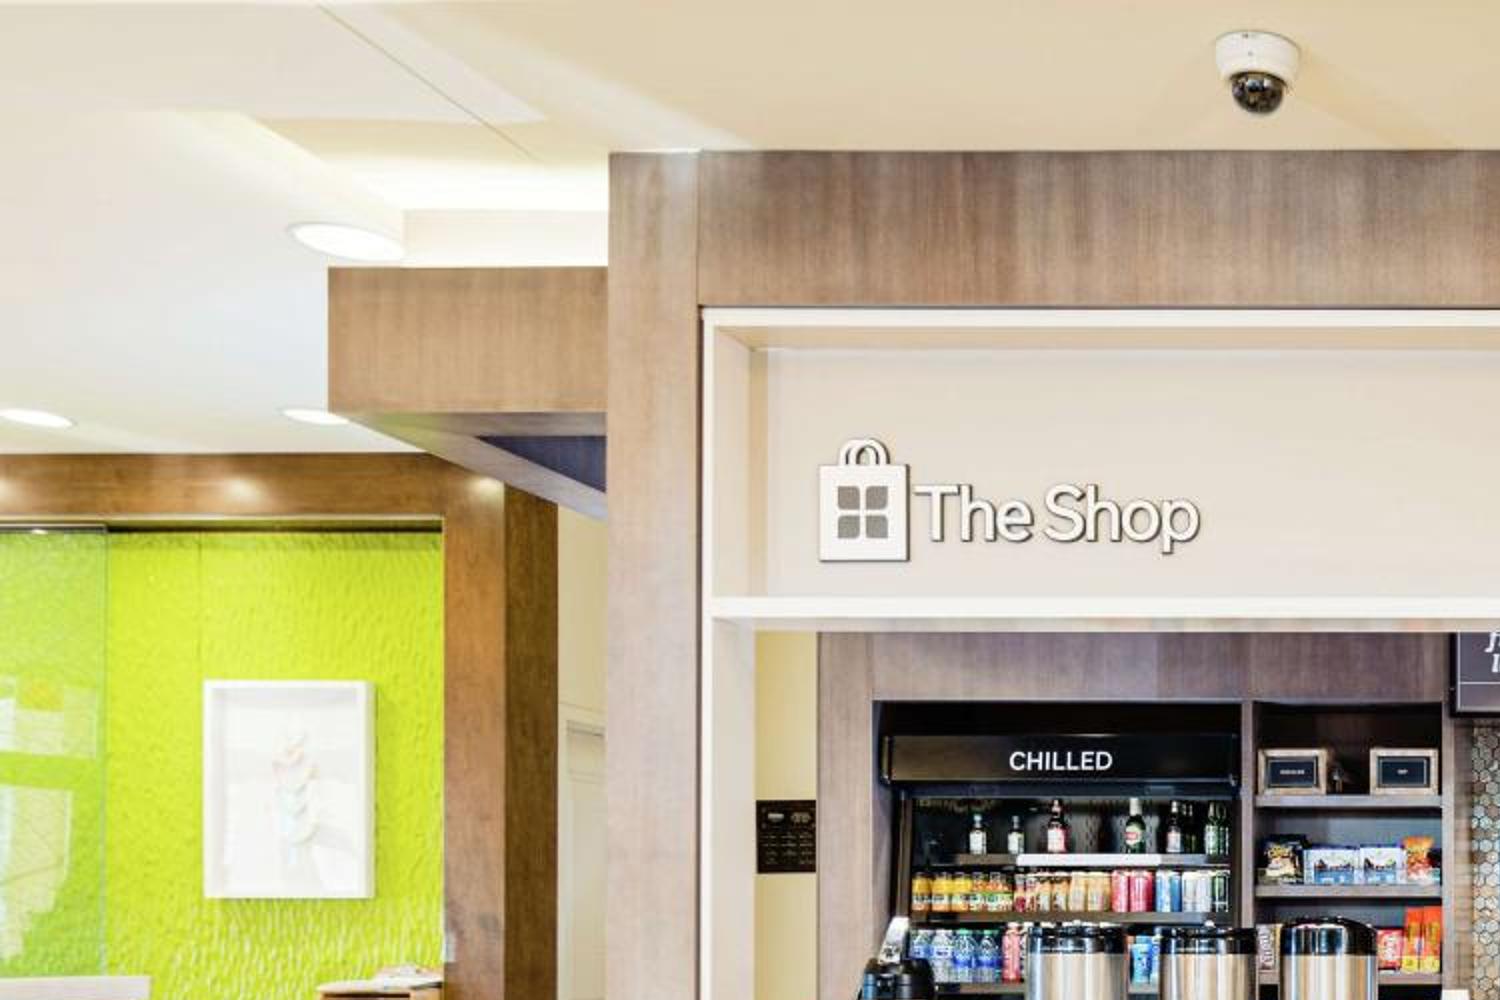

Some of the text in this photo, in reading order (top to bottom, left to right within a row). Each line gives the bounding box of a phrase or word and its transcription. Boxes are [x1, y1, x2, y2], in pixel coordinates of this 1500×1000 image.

[913, 483, 1200, 555] The Shop
[1009, 751, 1113, 771] CHILLED
